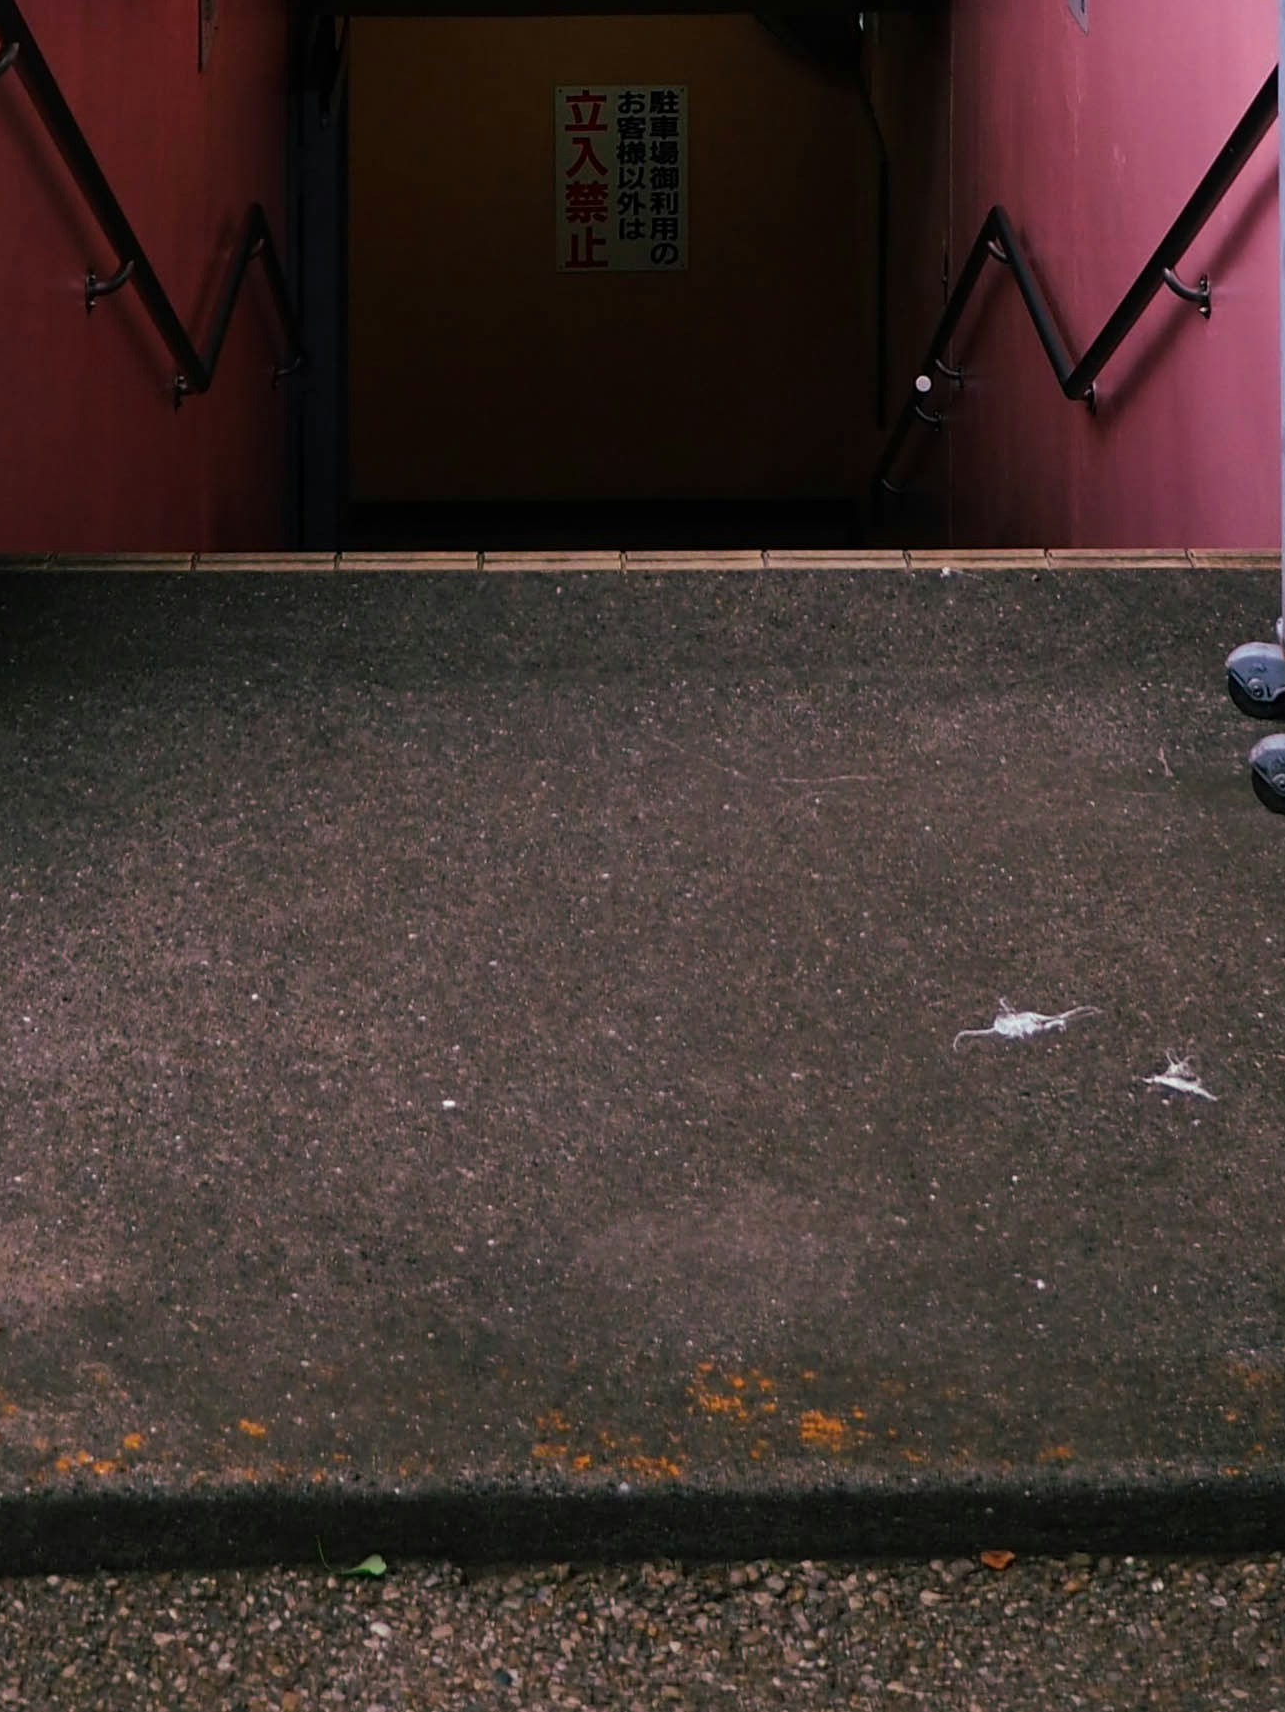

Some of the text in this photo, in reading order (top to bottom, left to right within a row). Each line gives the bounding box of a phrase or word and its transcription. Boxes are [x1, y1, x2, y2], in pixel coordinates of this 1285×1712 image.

[564, 89, 609, 269] 立入禁止
[616, 90, 647, 241] お客様以外は
[649, 90, 680, 265] 駐車場御利用の
